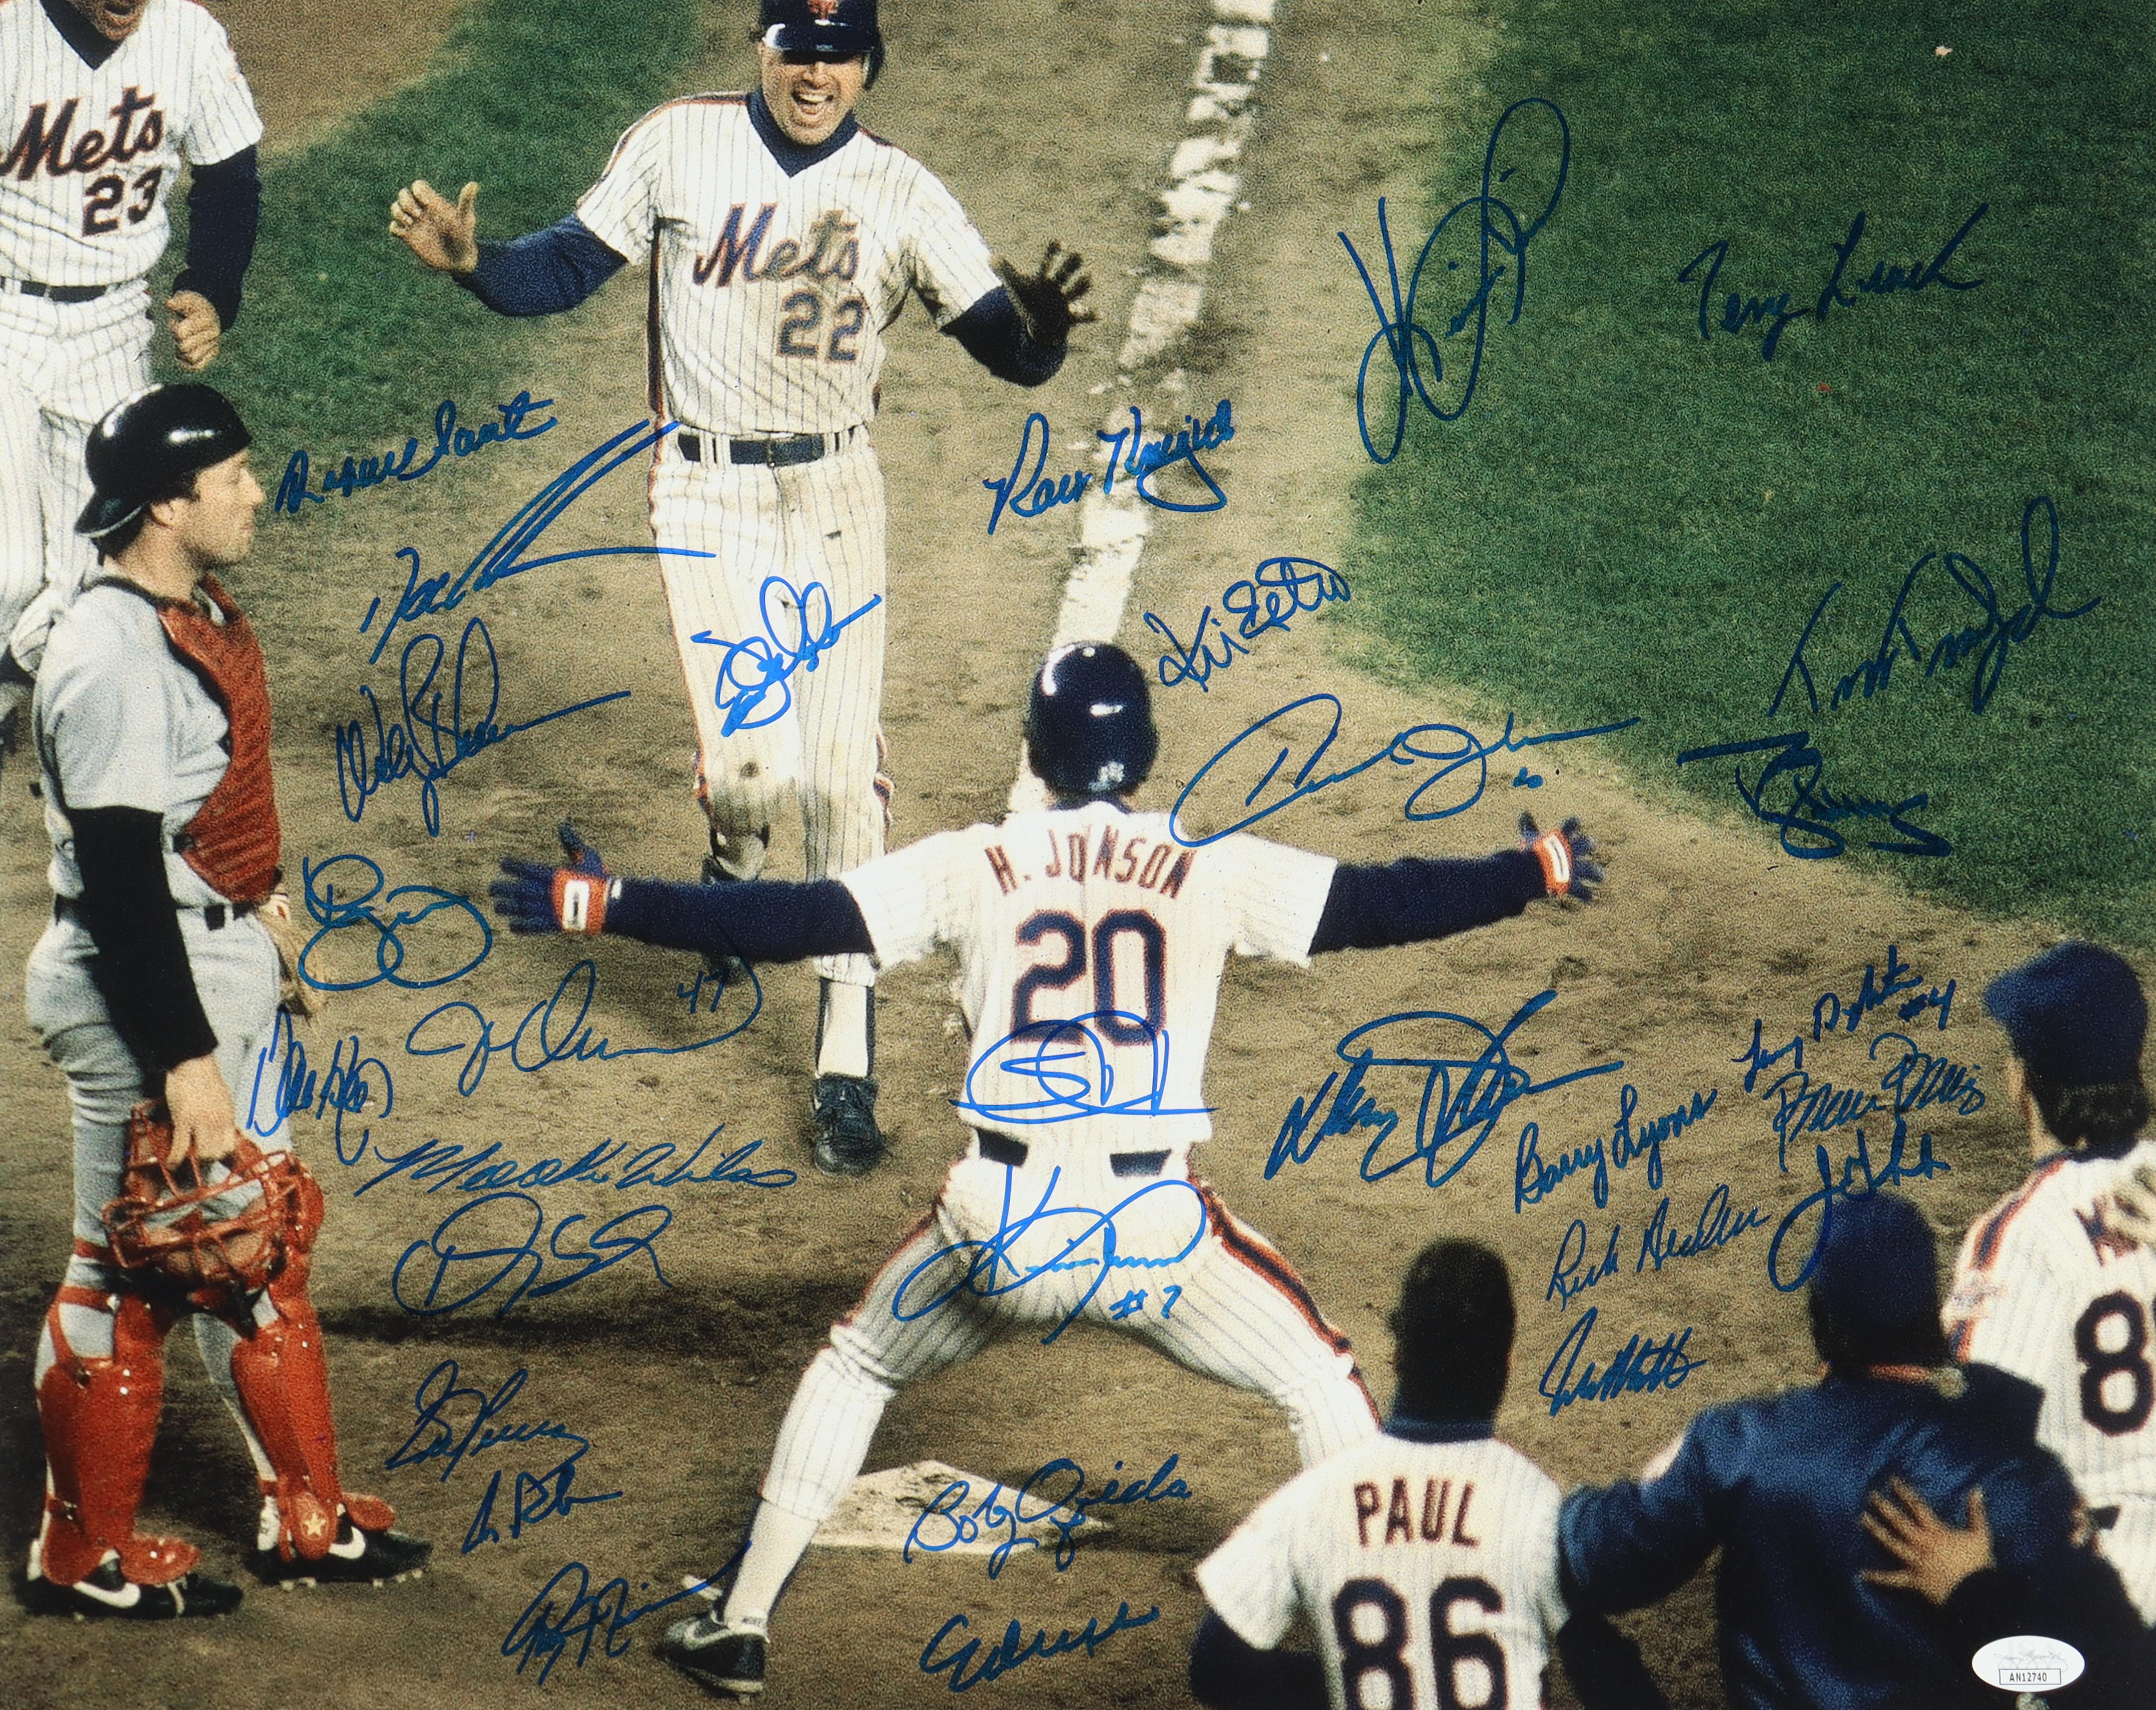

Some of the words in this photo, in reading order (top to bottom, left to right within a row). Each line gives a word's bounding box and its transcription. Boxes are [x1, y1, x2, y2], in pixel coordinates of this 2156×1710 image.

[0, 85, 164, 181] Mets
[82, 166, 162, 237] 23
[693, 203, 859, 288] Mets
[776, 289, 868, 364] 22
[985, 846, 1032, 896] H.
[1010, 908, 1167, 1046] 20
[1353, 1477, 1481, 1547] PAUL
[1332, 1576, 1508, 1710] 86
[2009, 1672, 2047, 1682] AN12740
